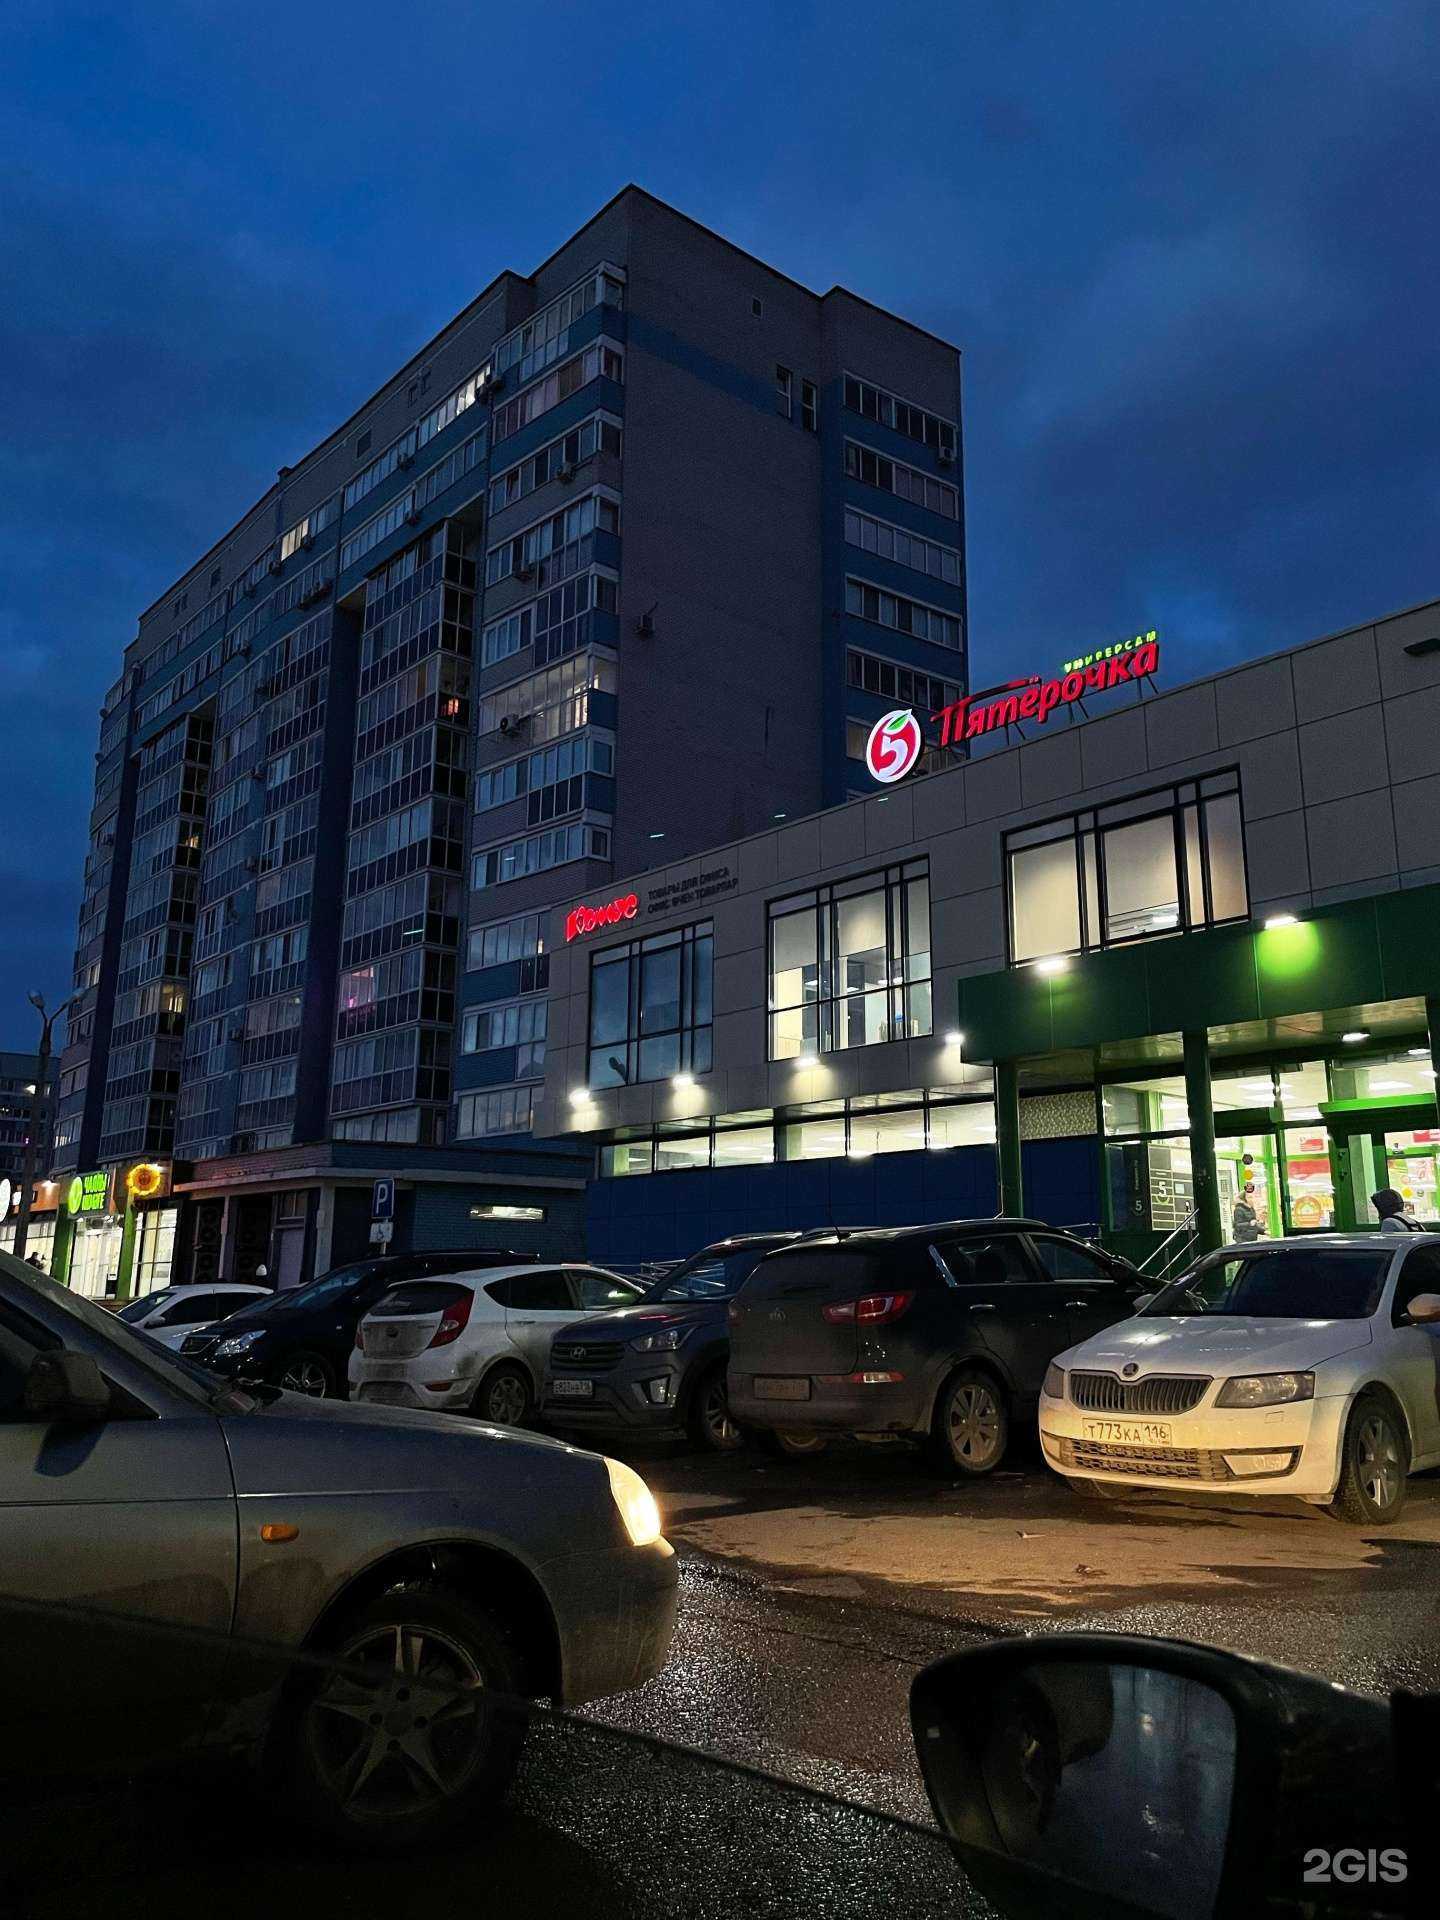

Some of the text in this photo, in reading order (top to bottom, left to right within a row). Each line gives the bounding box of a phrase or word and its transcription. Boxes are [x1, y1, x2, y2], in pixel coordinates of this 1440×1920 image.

[1063, 629, 1157, 673] УНИВЕРСАМ
[375, 1183, 388, 1214] P
[1087, 1421, 1167, 1441] Т773КА 116
